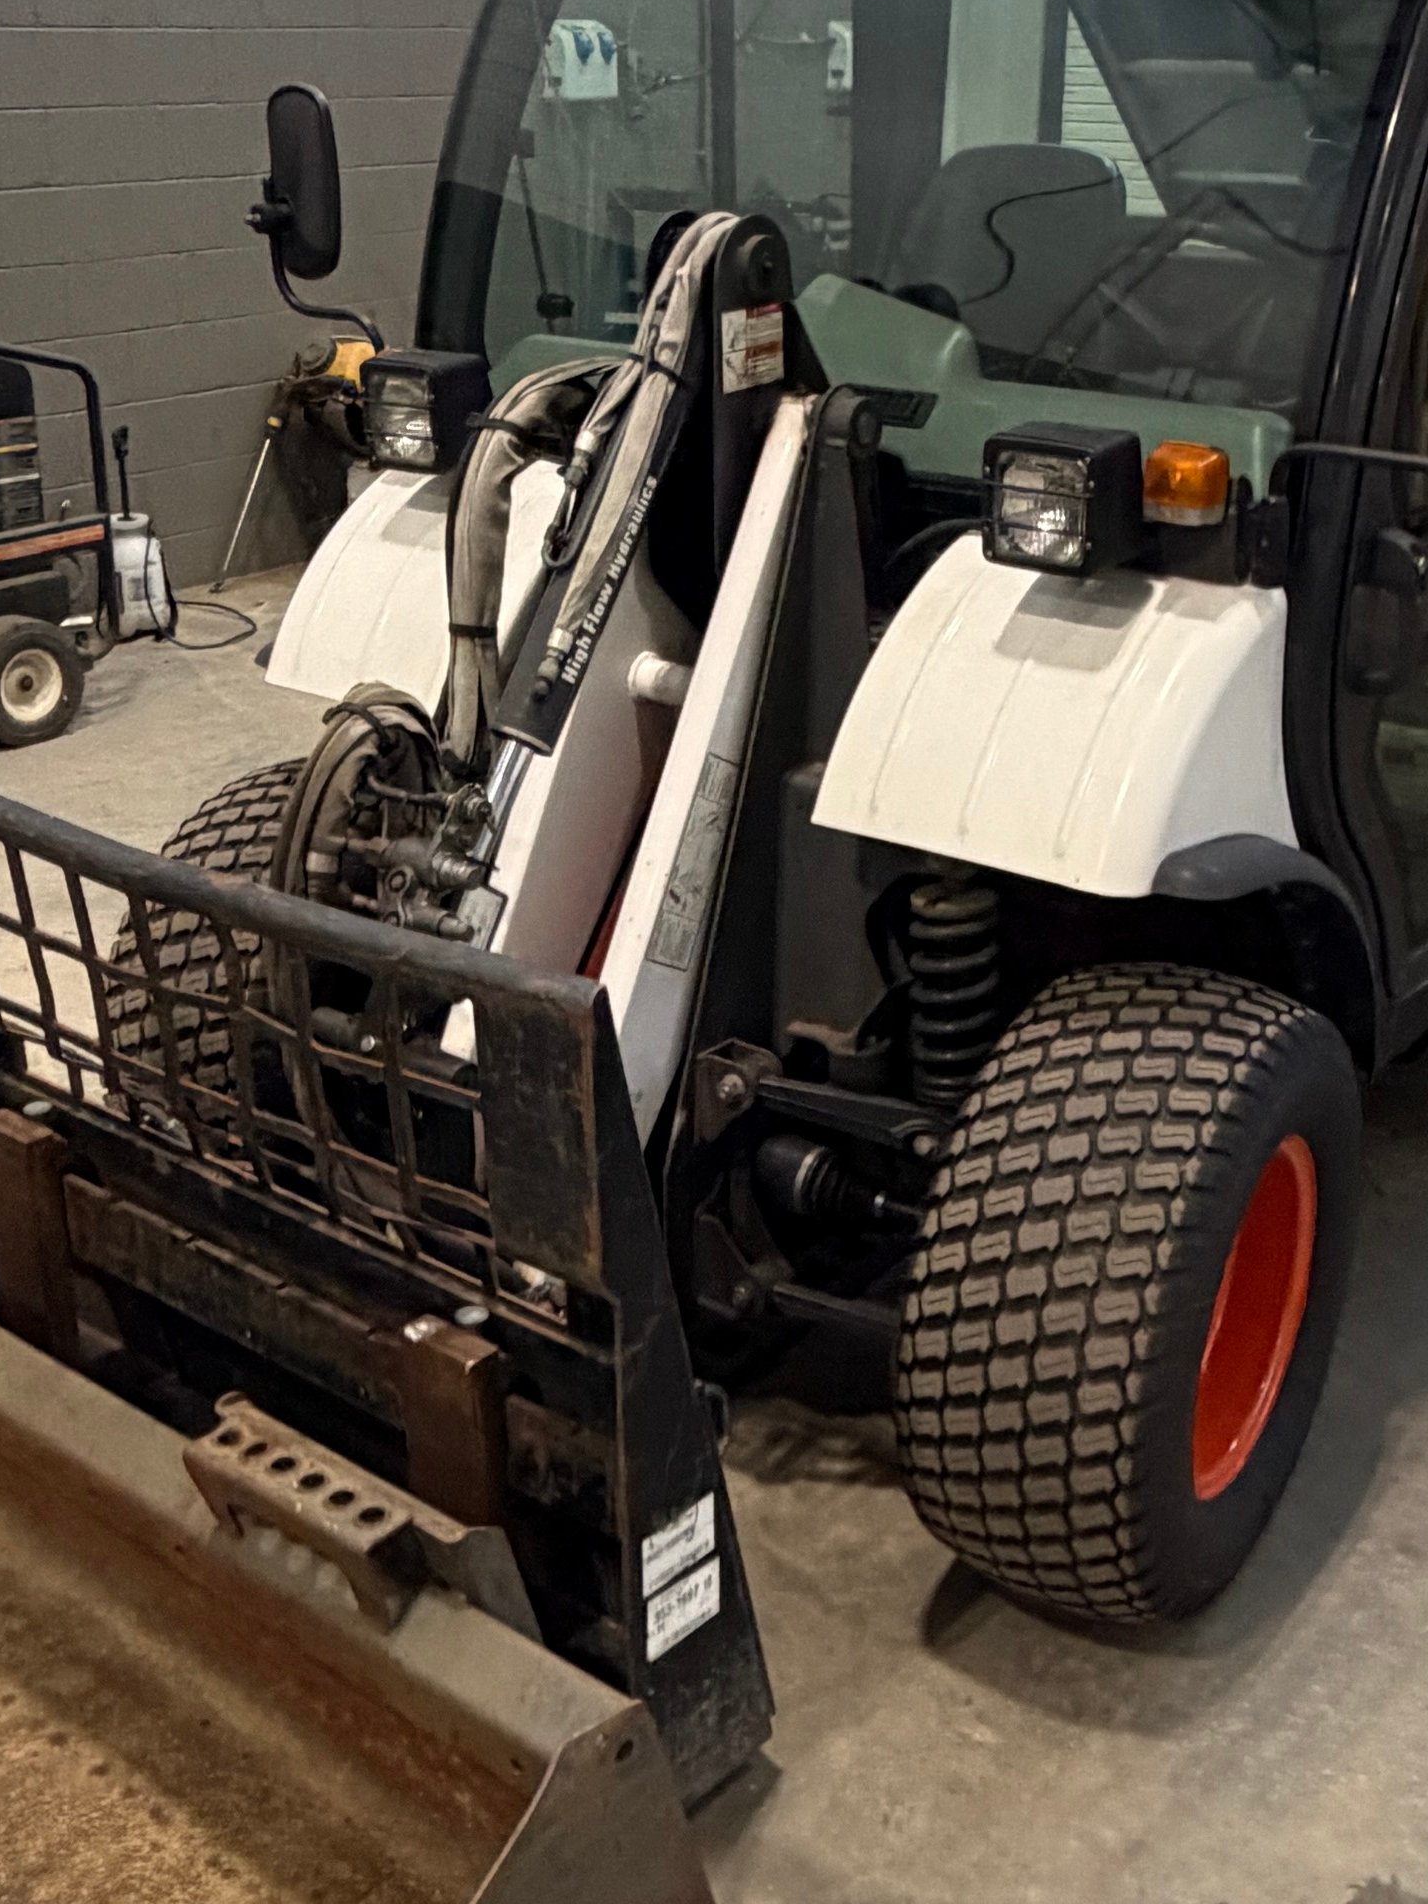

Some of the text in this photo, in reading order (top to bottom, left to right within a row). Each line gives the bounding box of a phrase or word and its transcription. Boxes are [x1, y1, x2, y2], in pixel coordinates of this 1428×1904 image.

[561, 475, 658, 685] High Flow Hydraulics
